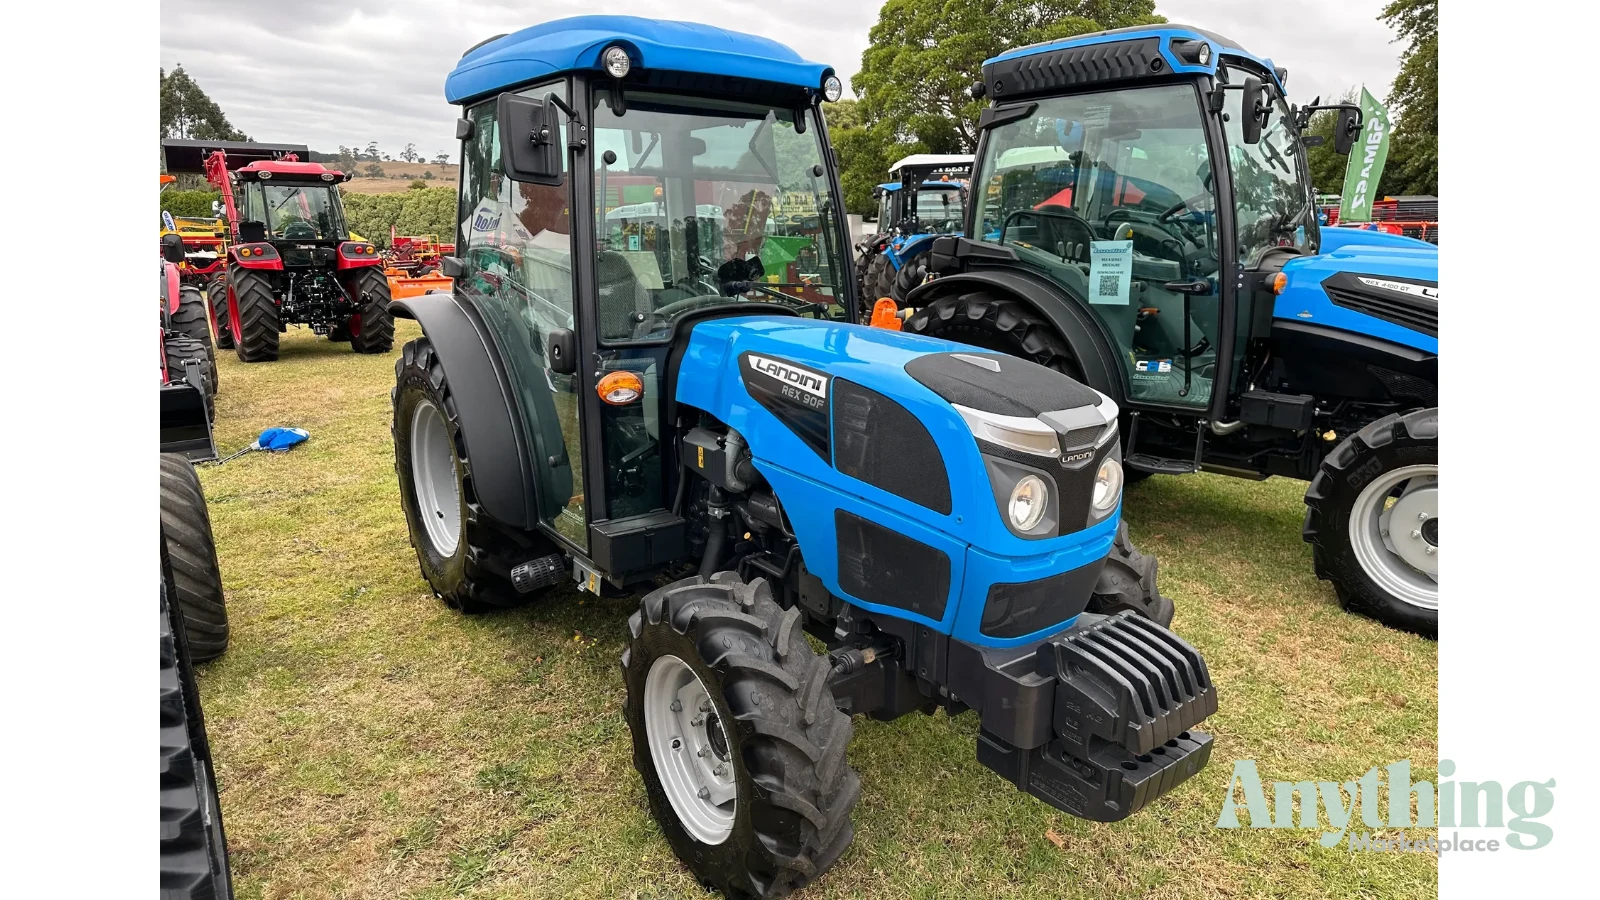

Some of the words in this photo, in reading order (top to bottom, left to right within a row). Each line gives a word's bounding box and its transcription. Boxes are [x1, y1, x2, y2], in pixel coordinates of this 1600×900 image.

[756, 359, 822, 391] LANDINI
[781, 385, 802, 401] REX
[803, 394, 825, 408] 90F
[1062, 451, 1092, 463] LANDINI
